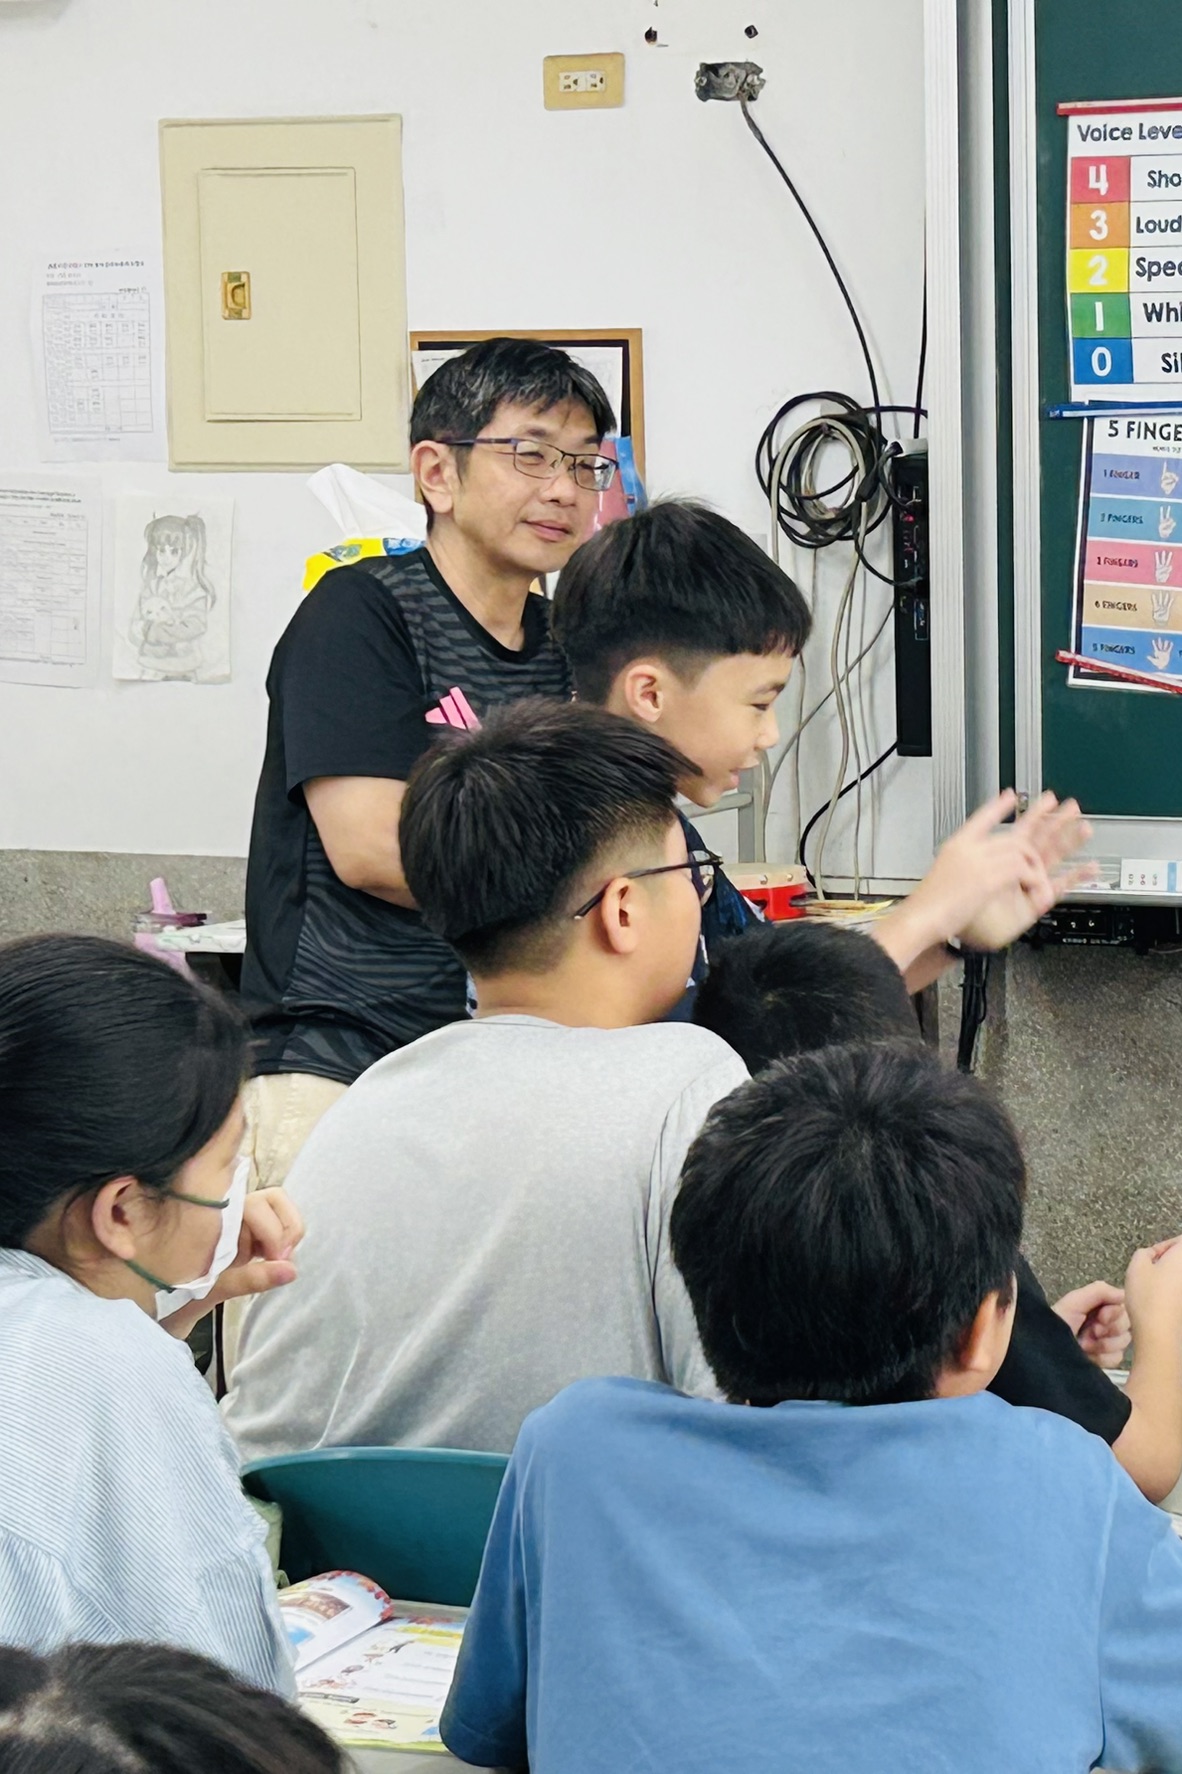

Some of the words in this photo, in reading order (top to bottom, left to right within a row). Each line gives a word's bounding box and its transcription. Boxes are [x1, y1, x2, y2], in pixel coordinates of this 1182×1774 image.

[1077, 123, 1132, 142] Voice
[1088, 164, 1109, 196] 4
[1089, 210, 1109, 241] 3
[1136, 215, 1182, 233] Loud
[1088, 255, 1109, 286] 2
[1094, 301, 1104, 332] 1
[1091, 346, 1112, 377] 0
[1107, 420, 1119, 438] 5
